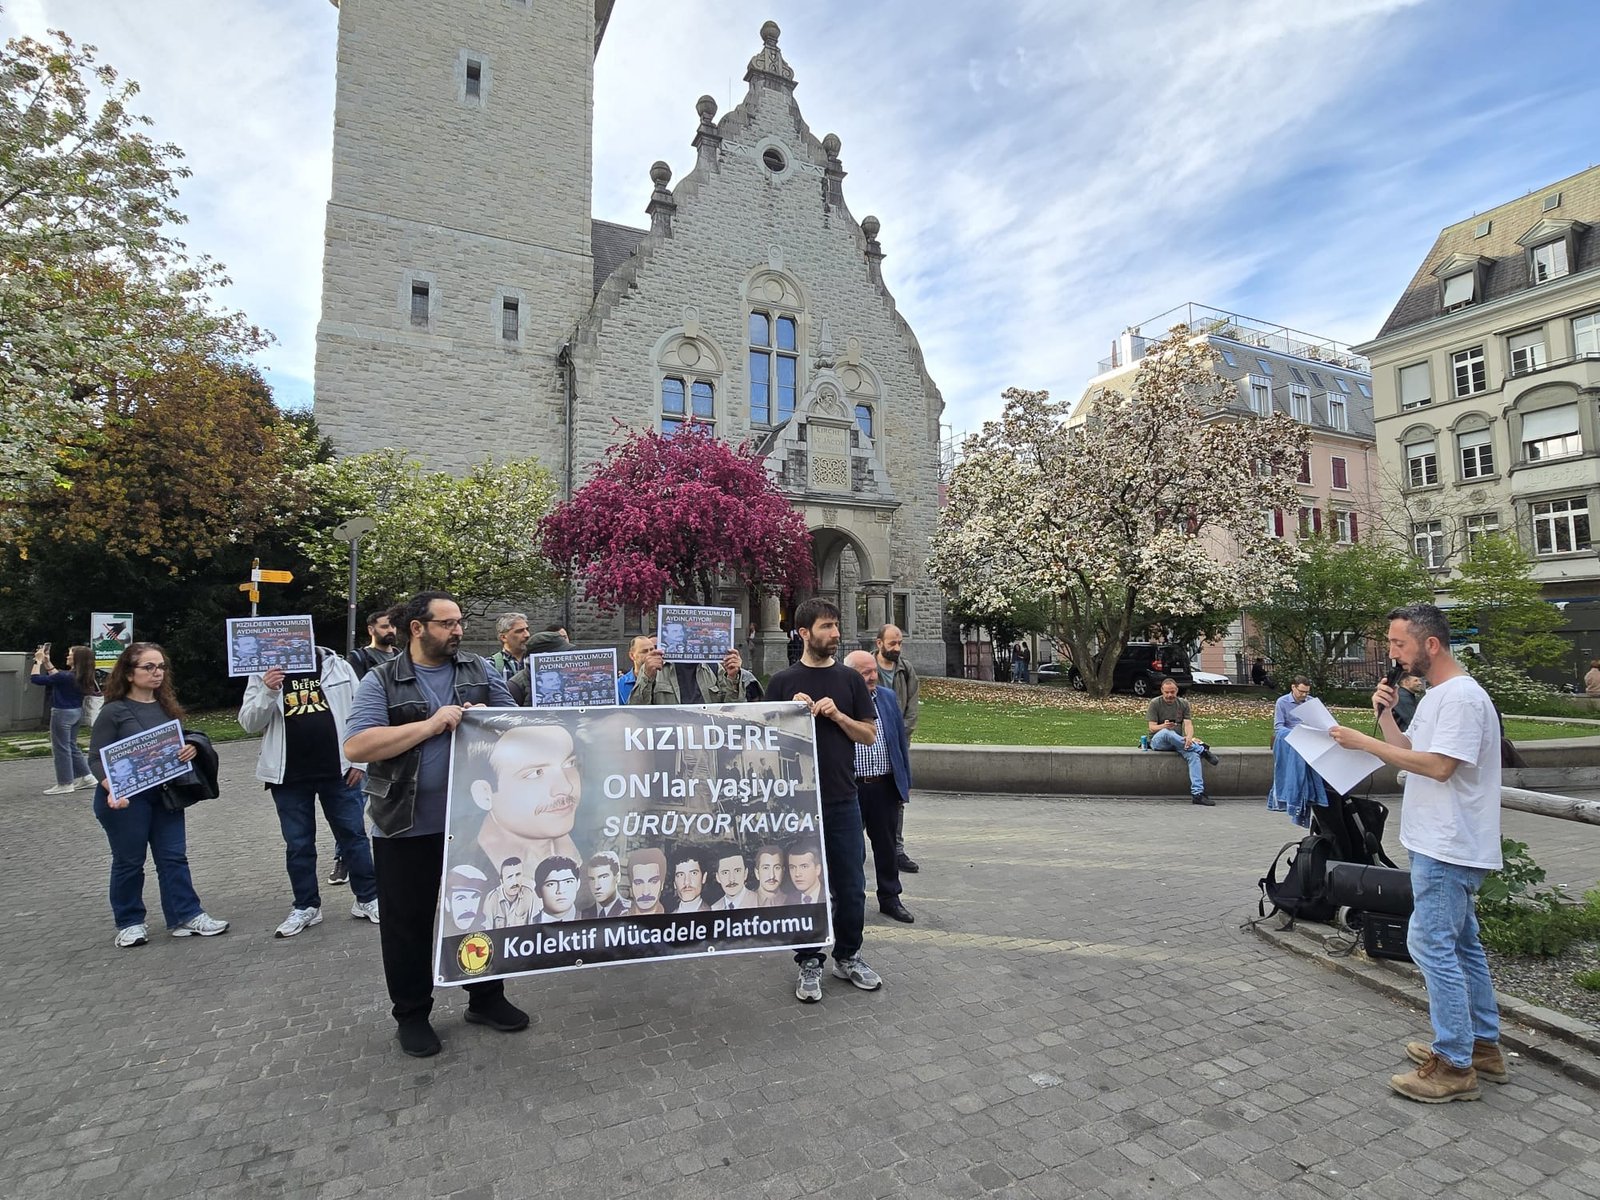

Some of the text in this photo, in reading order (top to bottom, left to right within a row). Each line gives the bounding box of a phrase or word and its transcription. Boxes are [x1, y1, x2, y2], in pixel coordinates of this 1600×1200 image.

[539, 655, 574, 663] KIZILDERE
[291, 680, 321, 690] BEERS
[108, 738, 140, 755] KIZILDERE
[141, 725, 177, 742] YOLUMUZU
[624, 725, 781, 751] KIZILDERE
[706, 772, 799, 807] yaşiyor
[602, 810, 815, 837] SÜRÜYOR KAVGA
[503, 915, 813, 959] Kolektif Mücadele Platformu
